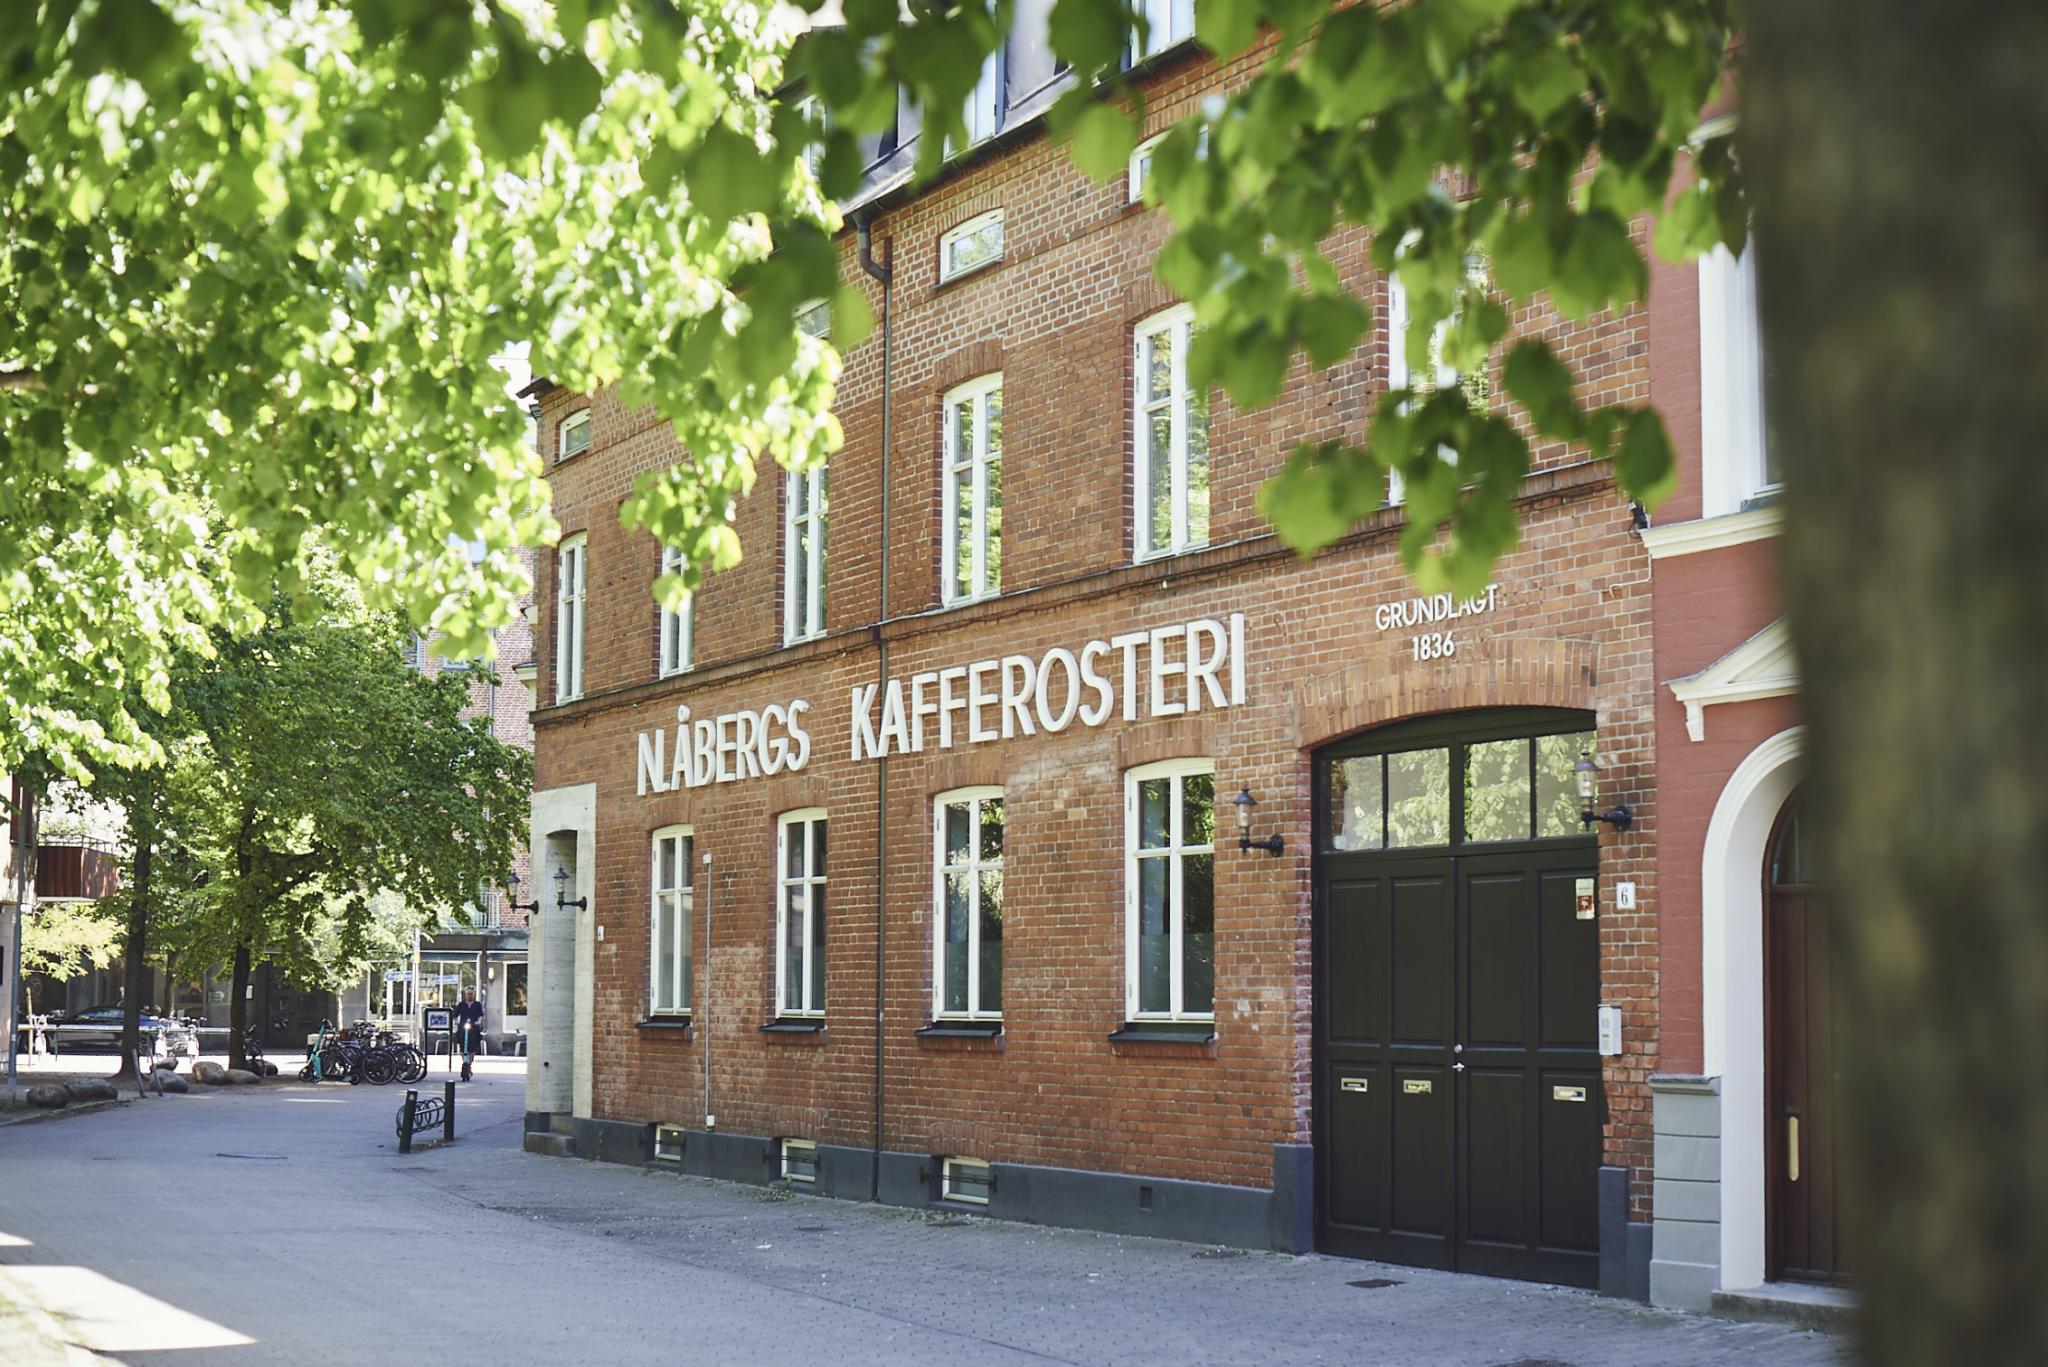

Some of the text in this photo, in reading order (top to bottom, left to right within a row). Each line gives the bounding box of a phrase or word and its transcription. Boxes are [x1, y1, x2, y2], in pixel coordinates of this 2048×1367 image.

[1375, 584, 1498, 631] GRUNDLAGT
[1412, 631, 1456, 661] 1836
[851, 612, 1246, 762] KAFFEROSTERI
[1621, 887, 1629, 906] 6
